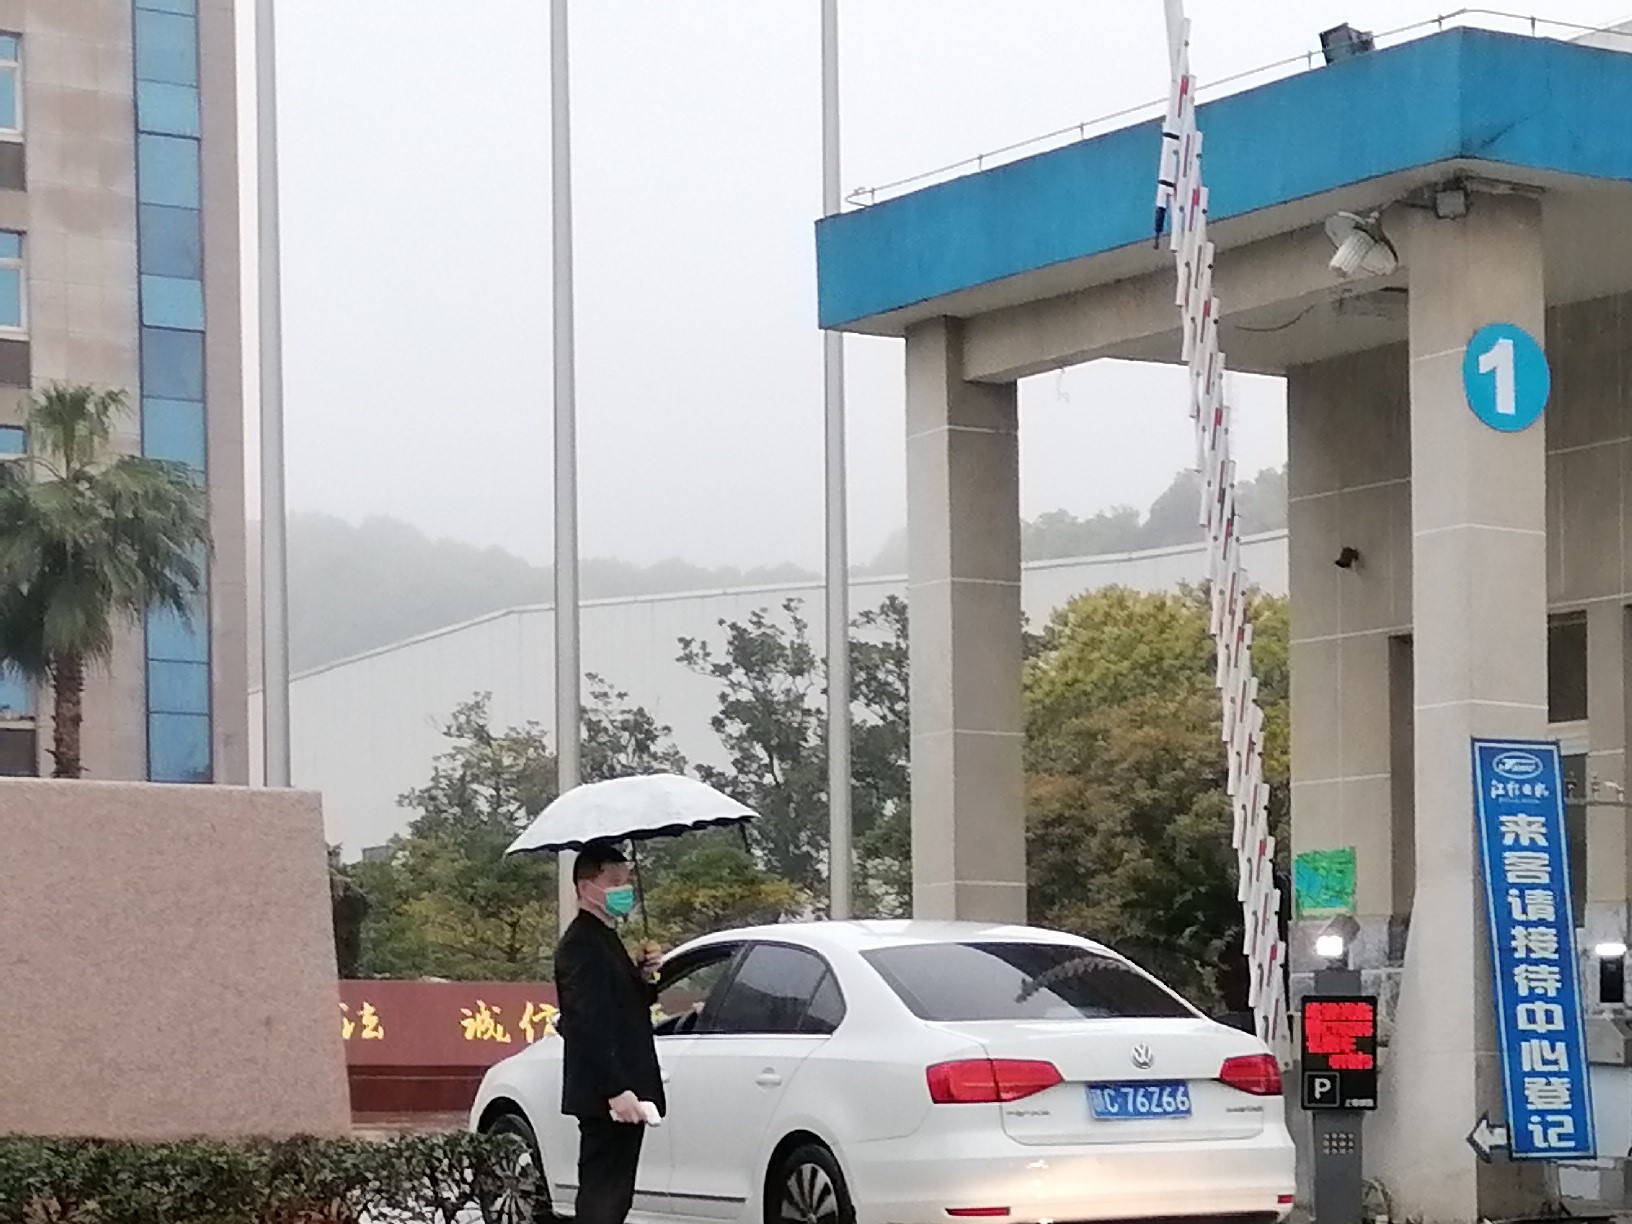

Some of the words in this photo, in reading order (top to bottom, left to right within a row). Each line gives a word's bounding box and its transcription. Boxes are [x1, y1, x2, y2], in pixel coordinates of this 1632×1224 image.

[1478, 338, 1516, 415] 1
[1499, 812, 1576, 1149] 来客请接待中心登记
[1314, 1078, 1331, 1100] P
